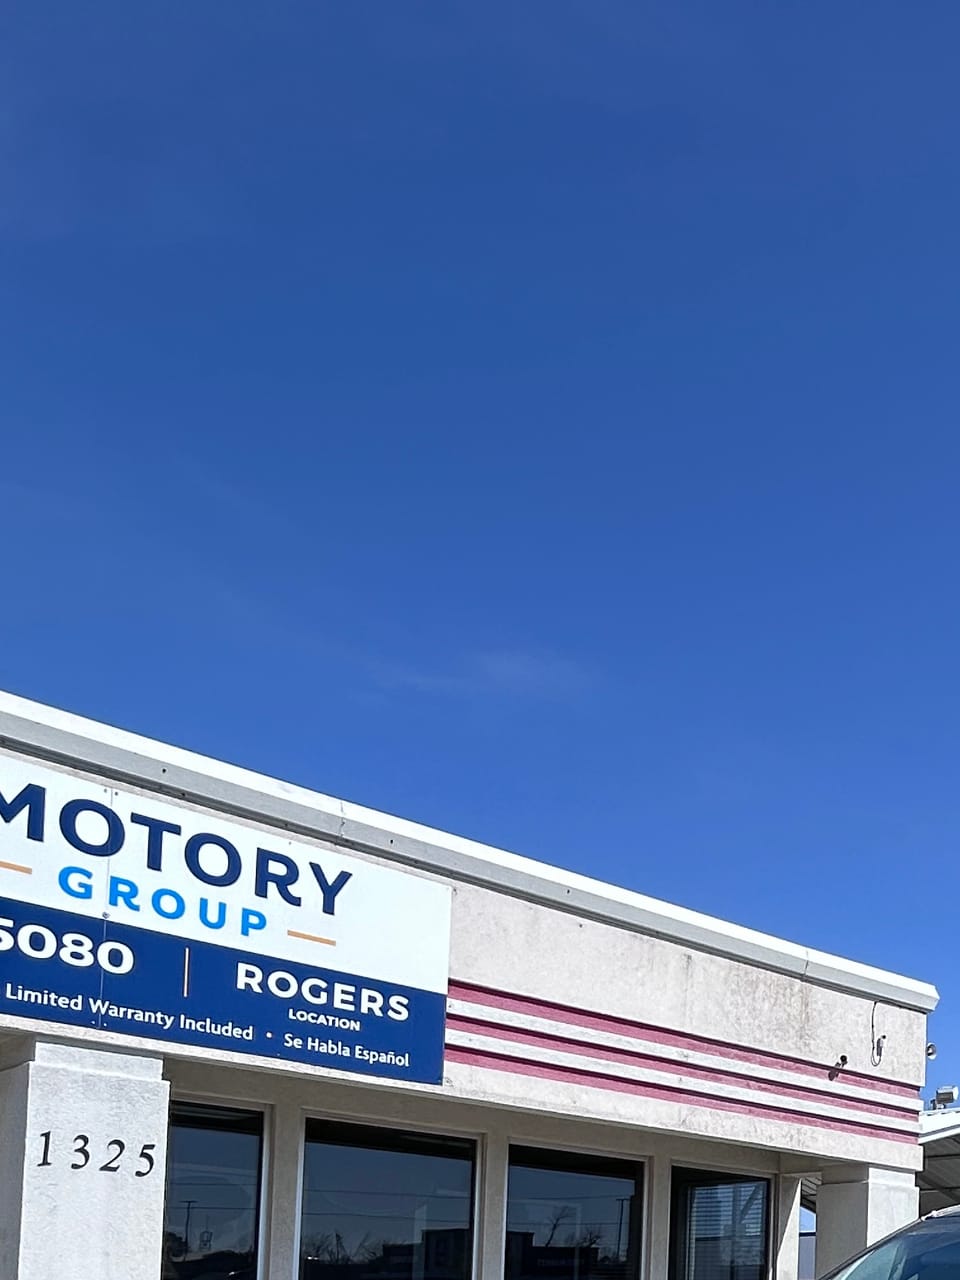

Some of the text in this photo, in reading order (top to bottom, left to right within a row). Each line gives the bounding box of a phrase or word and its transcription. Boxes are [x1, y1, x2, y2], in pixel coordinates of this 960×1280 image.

[0, 783, 353, 916] MOTORY
[58, 866, 267, 937] GROUP
[236, 962, 409, 1021] ROGERS
[288, 1008, 360, 1032] LOCATION
[5, 983, 410, 1068] Limited Warranty Included Se Habla Español
[37, 1131, 155, 1177] 1325
